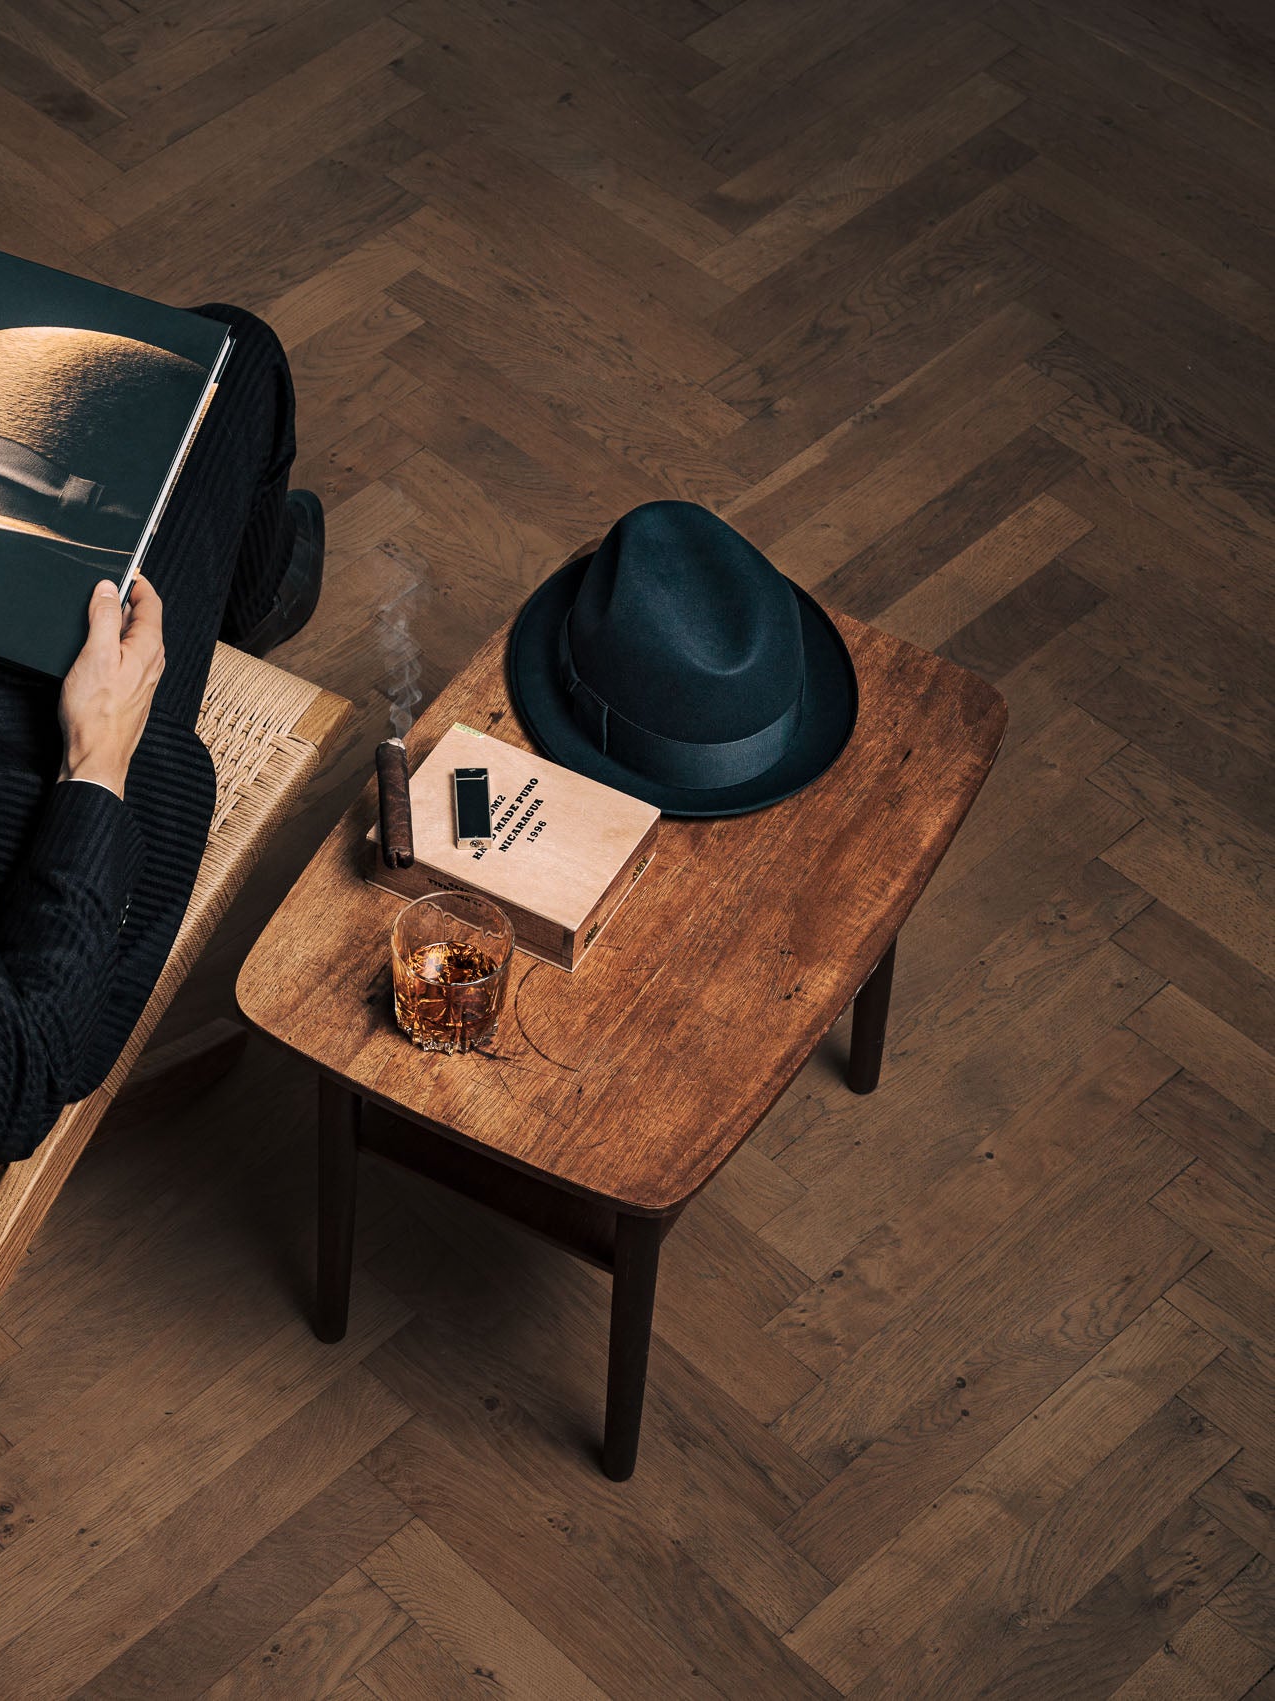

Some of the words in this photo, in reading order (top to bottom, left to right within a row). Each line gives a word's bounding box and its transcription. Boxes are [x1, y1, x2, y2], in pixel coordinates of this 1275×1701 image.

[494, 804, 519, 832] MADE
[515, 778, 539, 804] PURO
[498, 798, 544, 852] NICARAGUA
[527, 820, 547, 843] 1996
